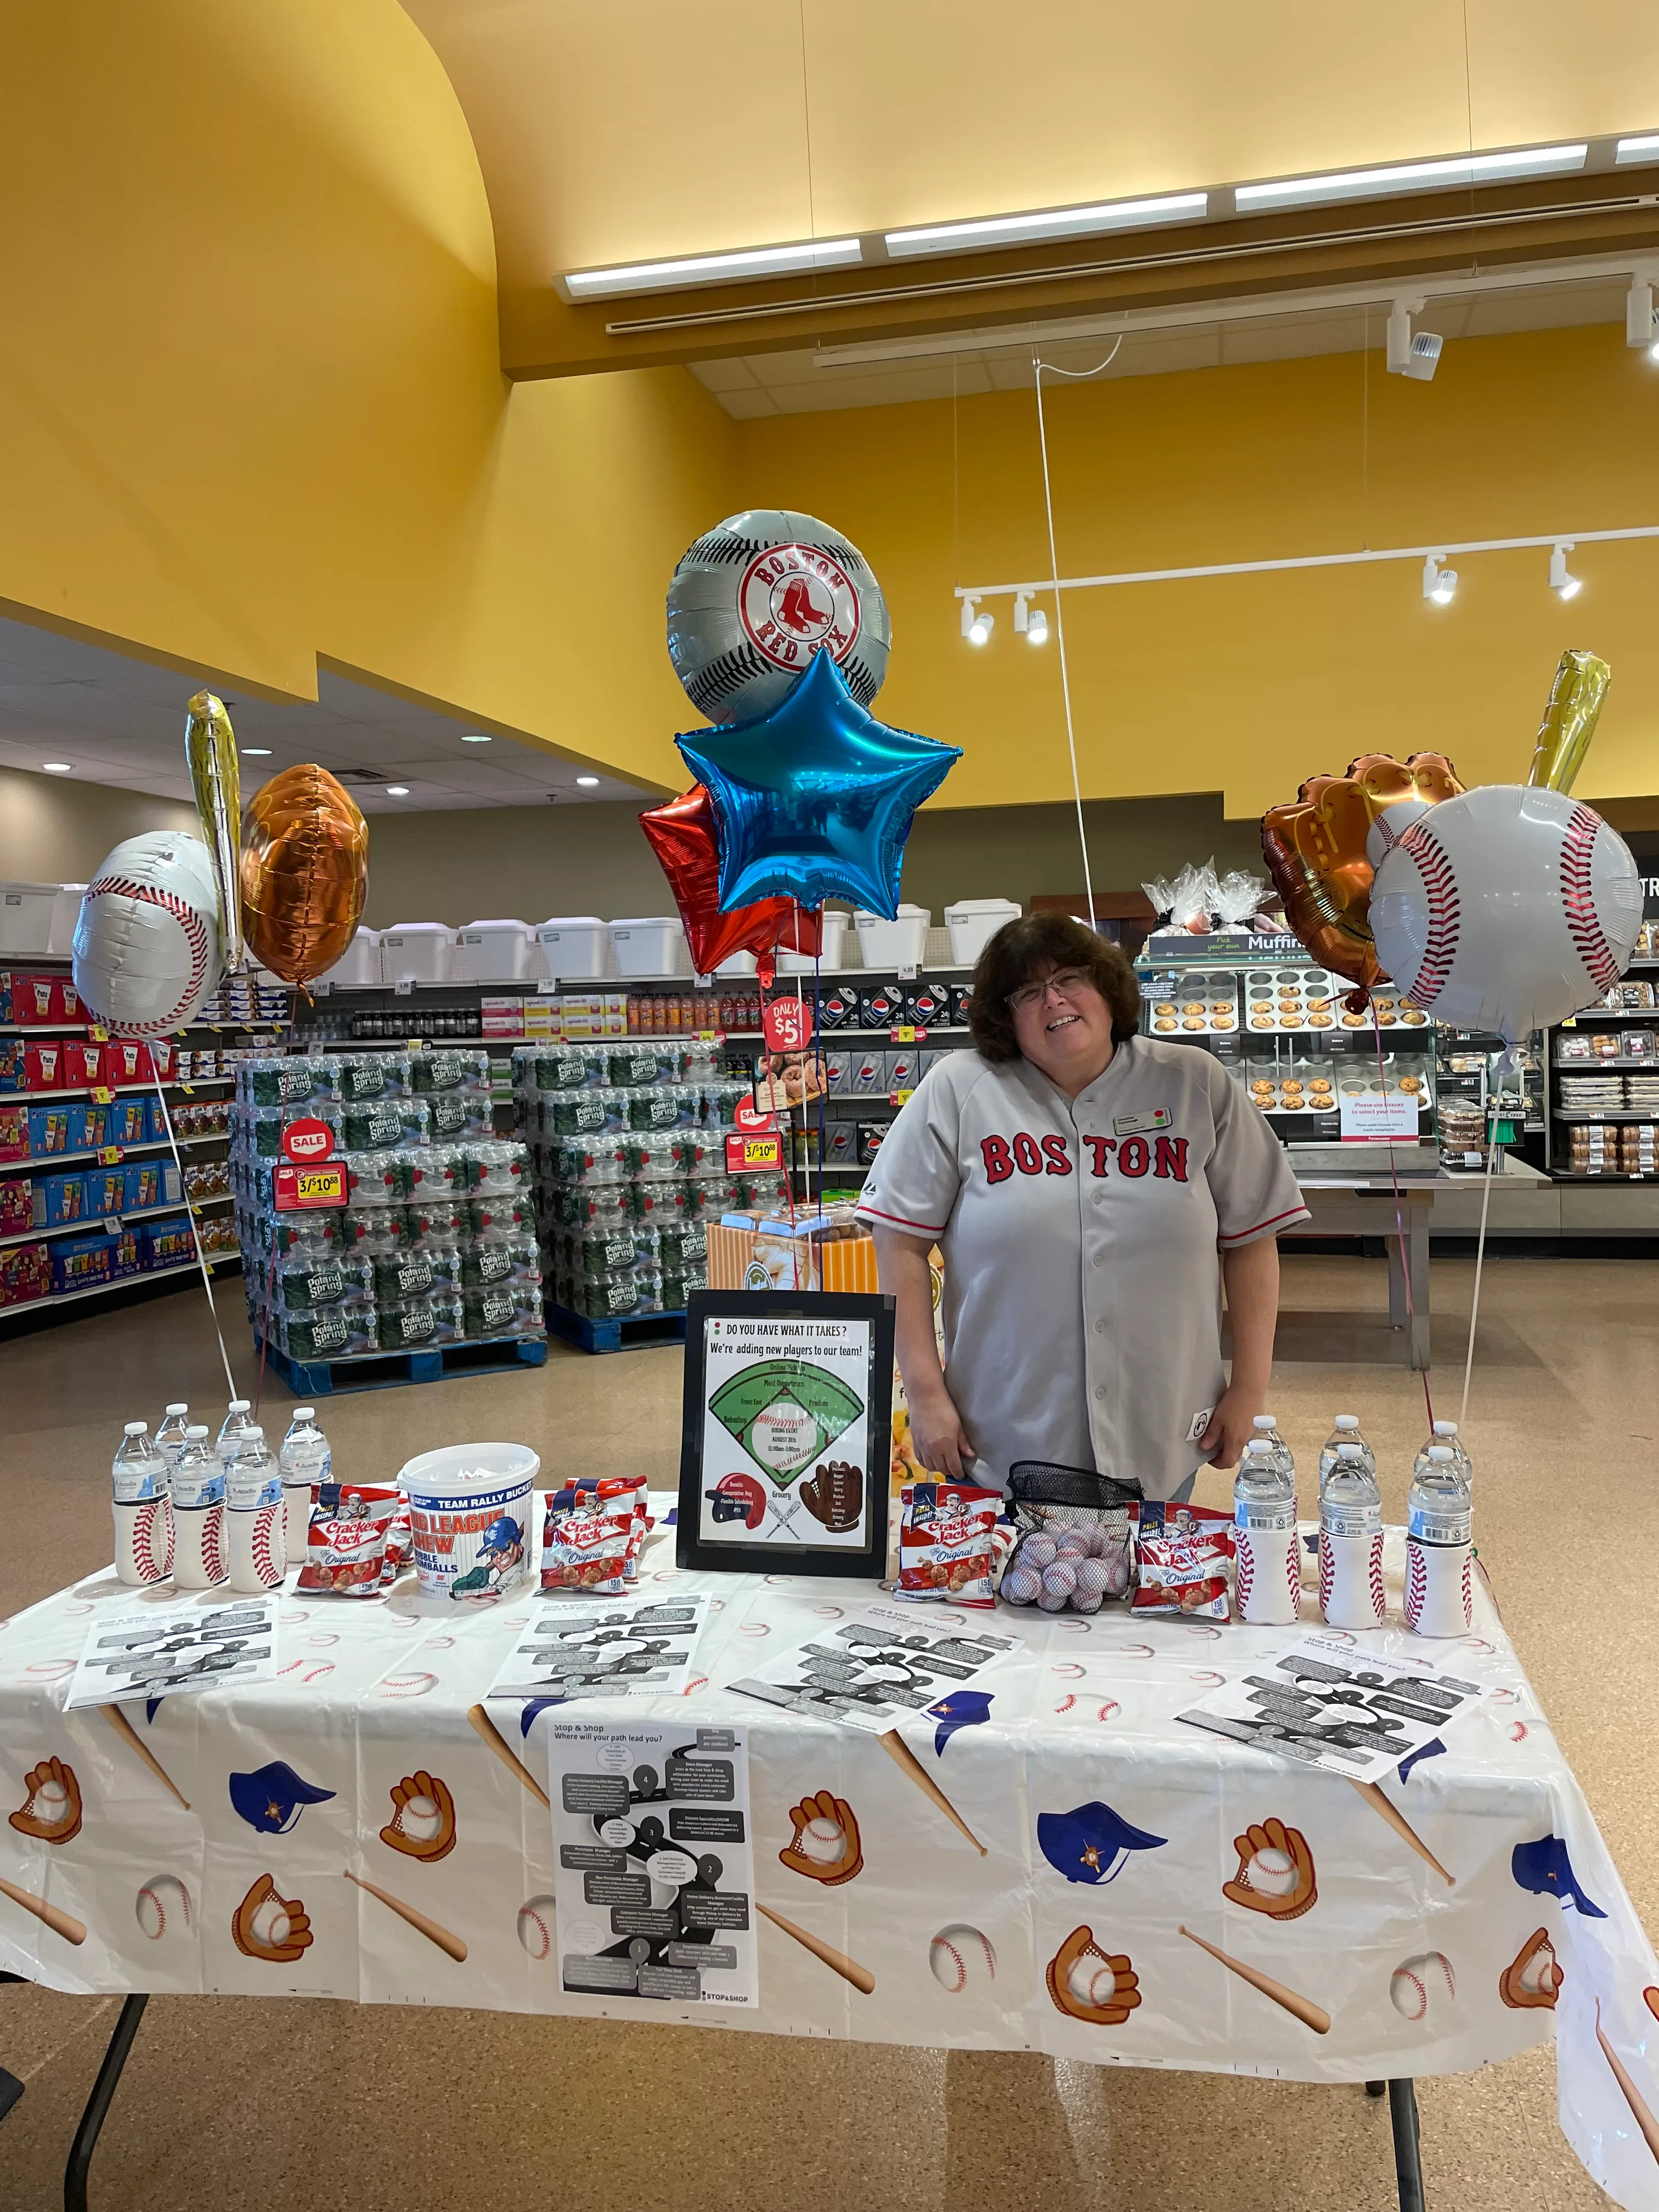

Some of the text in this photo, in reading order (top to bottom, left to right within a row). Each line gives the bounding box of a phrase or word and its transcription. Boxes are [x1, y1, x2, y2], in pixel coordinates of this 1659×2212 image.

[754, 551, 845, 592] BOSTON
[755, 620, 848, 662] RED SOX
[1248, 934, 1306, 950] Muffin
[773, 1002, 799, 1018] ONLY
[775, 1017, 799, 1044] $5
[557, 1058, 583, 1070] Poland
[352, 1069, 382, 1083] Poland
[559, 1066, 585, 1081] Spring
[354, 1076, 384, 1091] Spring
[575, 1103, 603, 1117] Poland
[742, 1110, 765, 1120] SA
[368, 1115, 399, 1130] Poland
[578, 1111, 605, 1126] Spring
[371, 1123, 401, 1141] Spring
[293, 1136, 324, 1148] SALE
[980, 1131, 1189, 1185] BOSTON
[605, 1240, 634, 1254] Poland
[607, 1248, 635, 1264] Spring
[307, 1272, 341, 1288] Poland
[398, 1265, 430, 1280] Poland
[310, 1280, 343, 1297] Spring
[400, 1272, 432, 1290] Spring
[311, 1320, 346, 1336] Poland
[727, 1324, 847, 1337] DO YOU HAVE WHAT IT TAKES ?
[314, 1328, 347, 1347] Spring
[710, 1342, 862, 1357] We're adding new players to our team!
[438, 1499, 468, 1509] TEAM
[471, 1493, 504, 1507] RALLY
[506, 1480, 532, 1500] BUCKET
[772, 1491, 791, 1500] Grocery
[317, 1504, 334, 1513] PRIZE
[553, 1506, 569, 1516] PRIZE
[915, 1505, 930, 1514] PRIZE
[430, 1508, 505, 1534] LEAGUE
[564, 1516, 618, 1533] Cracker
[913, 1511, 933, 1524] INSIDE!
[928, 1513, 983, 1531] Cracker
[326, 1520, 380, 1534] Cracker
[1142, 1520, 1159, 1531] PRIZE
[327, 1533, 363, 1547] Jack
[568, 1527, 602, 1546] Jack
[934, 1528, 969, 1544] Jack
[1157, 1536, 1214, 1553] Cracker
[325, 1551, 361, 1566] Original
[568, 1548, 604, 1564] Original
[936, 1545, 973, 1562] Original
[1166, 1569, 1205, 1585] Original
[1214, 1599, 1222, 1608] 150
[1304, 1640, 1325, 1649] Where
[554, 1724, 573, 1733] Stop
[584, 1725, 604, 1733] Shop
[611, 1734, 627, 1742] path
[645, 1735, 663, 1743] you?
[707, 1993, 748, 2002] STOP&SHOP
